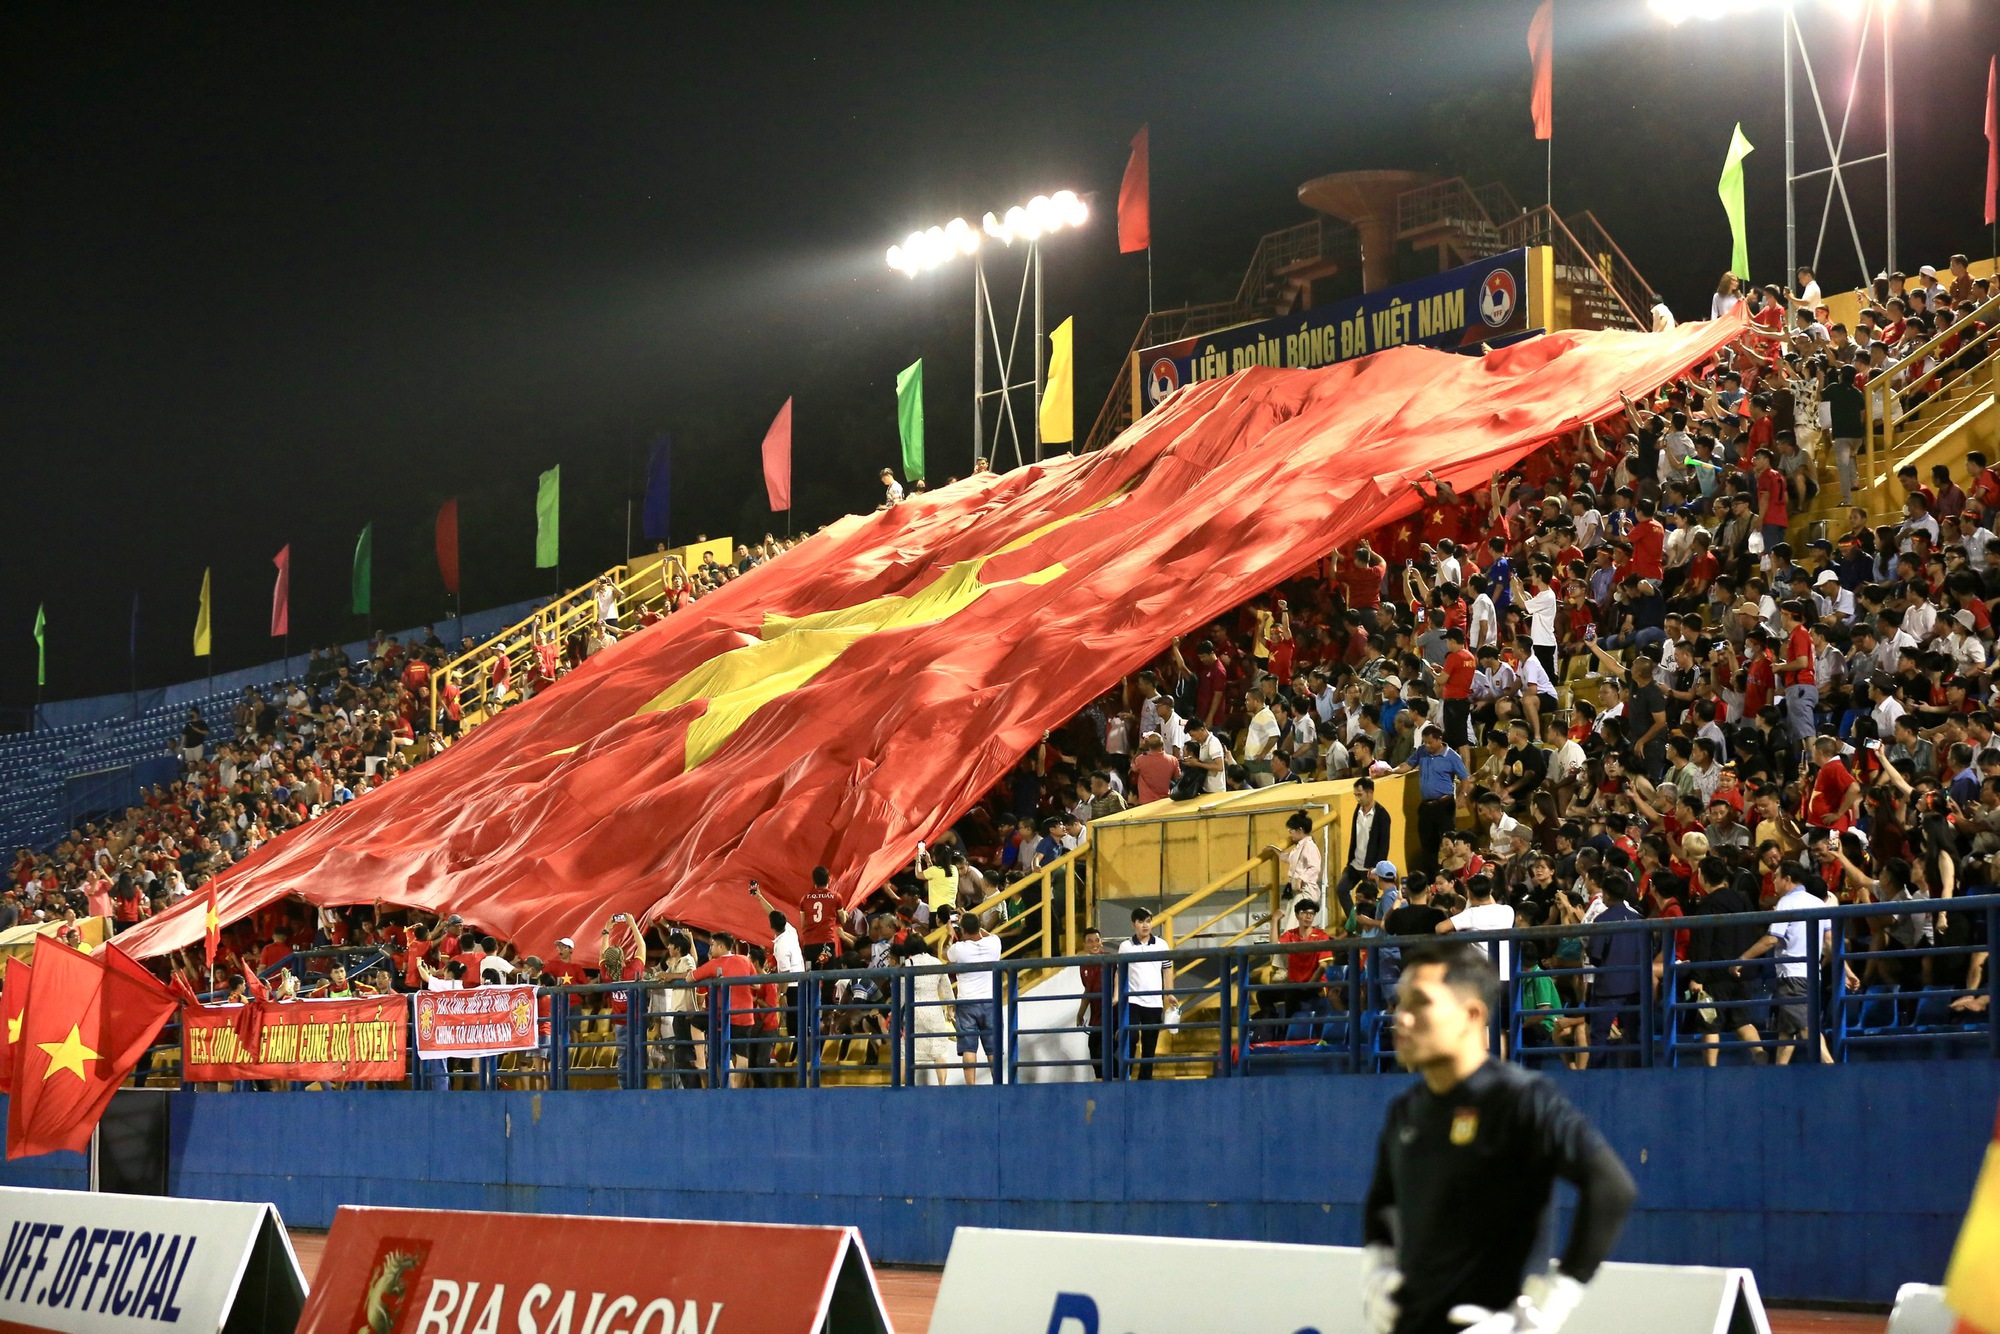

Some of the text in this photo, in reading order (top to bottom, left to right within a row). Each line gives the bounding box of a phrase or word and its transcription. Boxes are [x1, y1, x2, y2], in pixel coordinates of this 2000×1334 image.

[1286, 321, 1335, 369] BÓNG
[1341, 306, 1367, 359] ĐÁ
[1418, 288, 1465, 339] NAM
[813, 901, 823, 923] 3
[210, 1018, 238, 1064] LUÔN
[267, 1015, 299, 1063] HÀNH
[299, 1014, 330, 1063] CÙNG
[353, 1004, 390, 1062] TUYỂN
[416, 1279, 505, 1334] BIA
